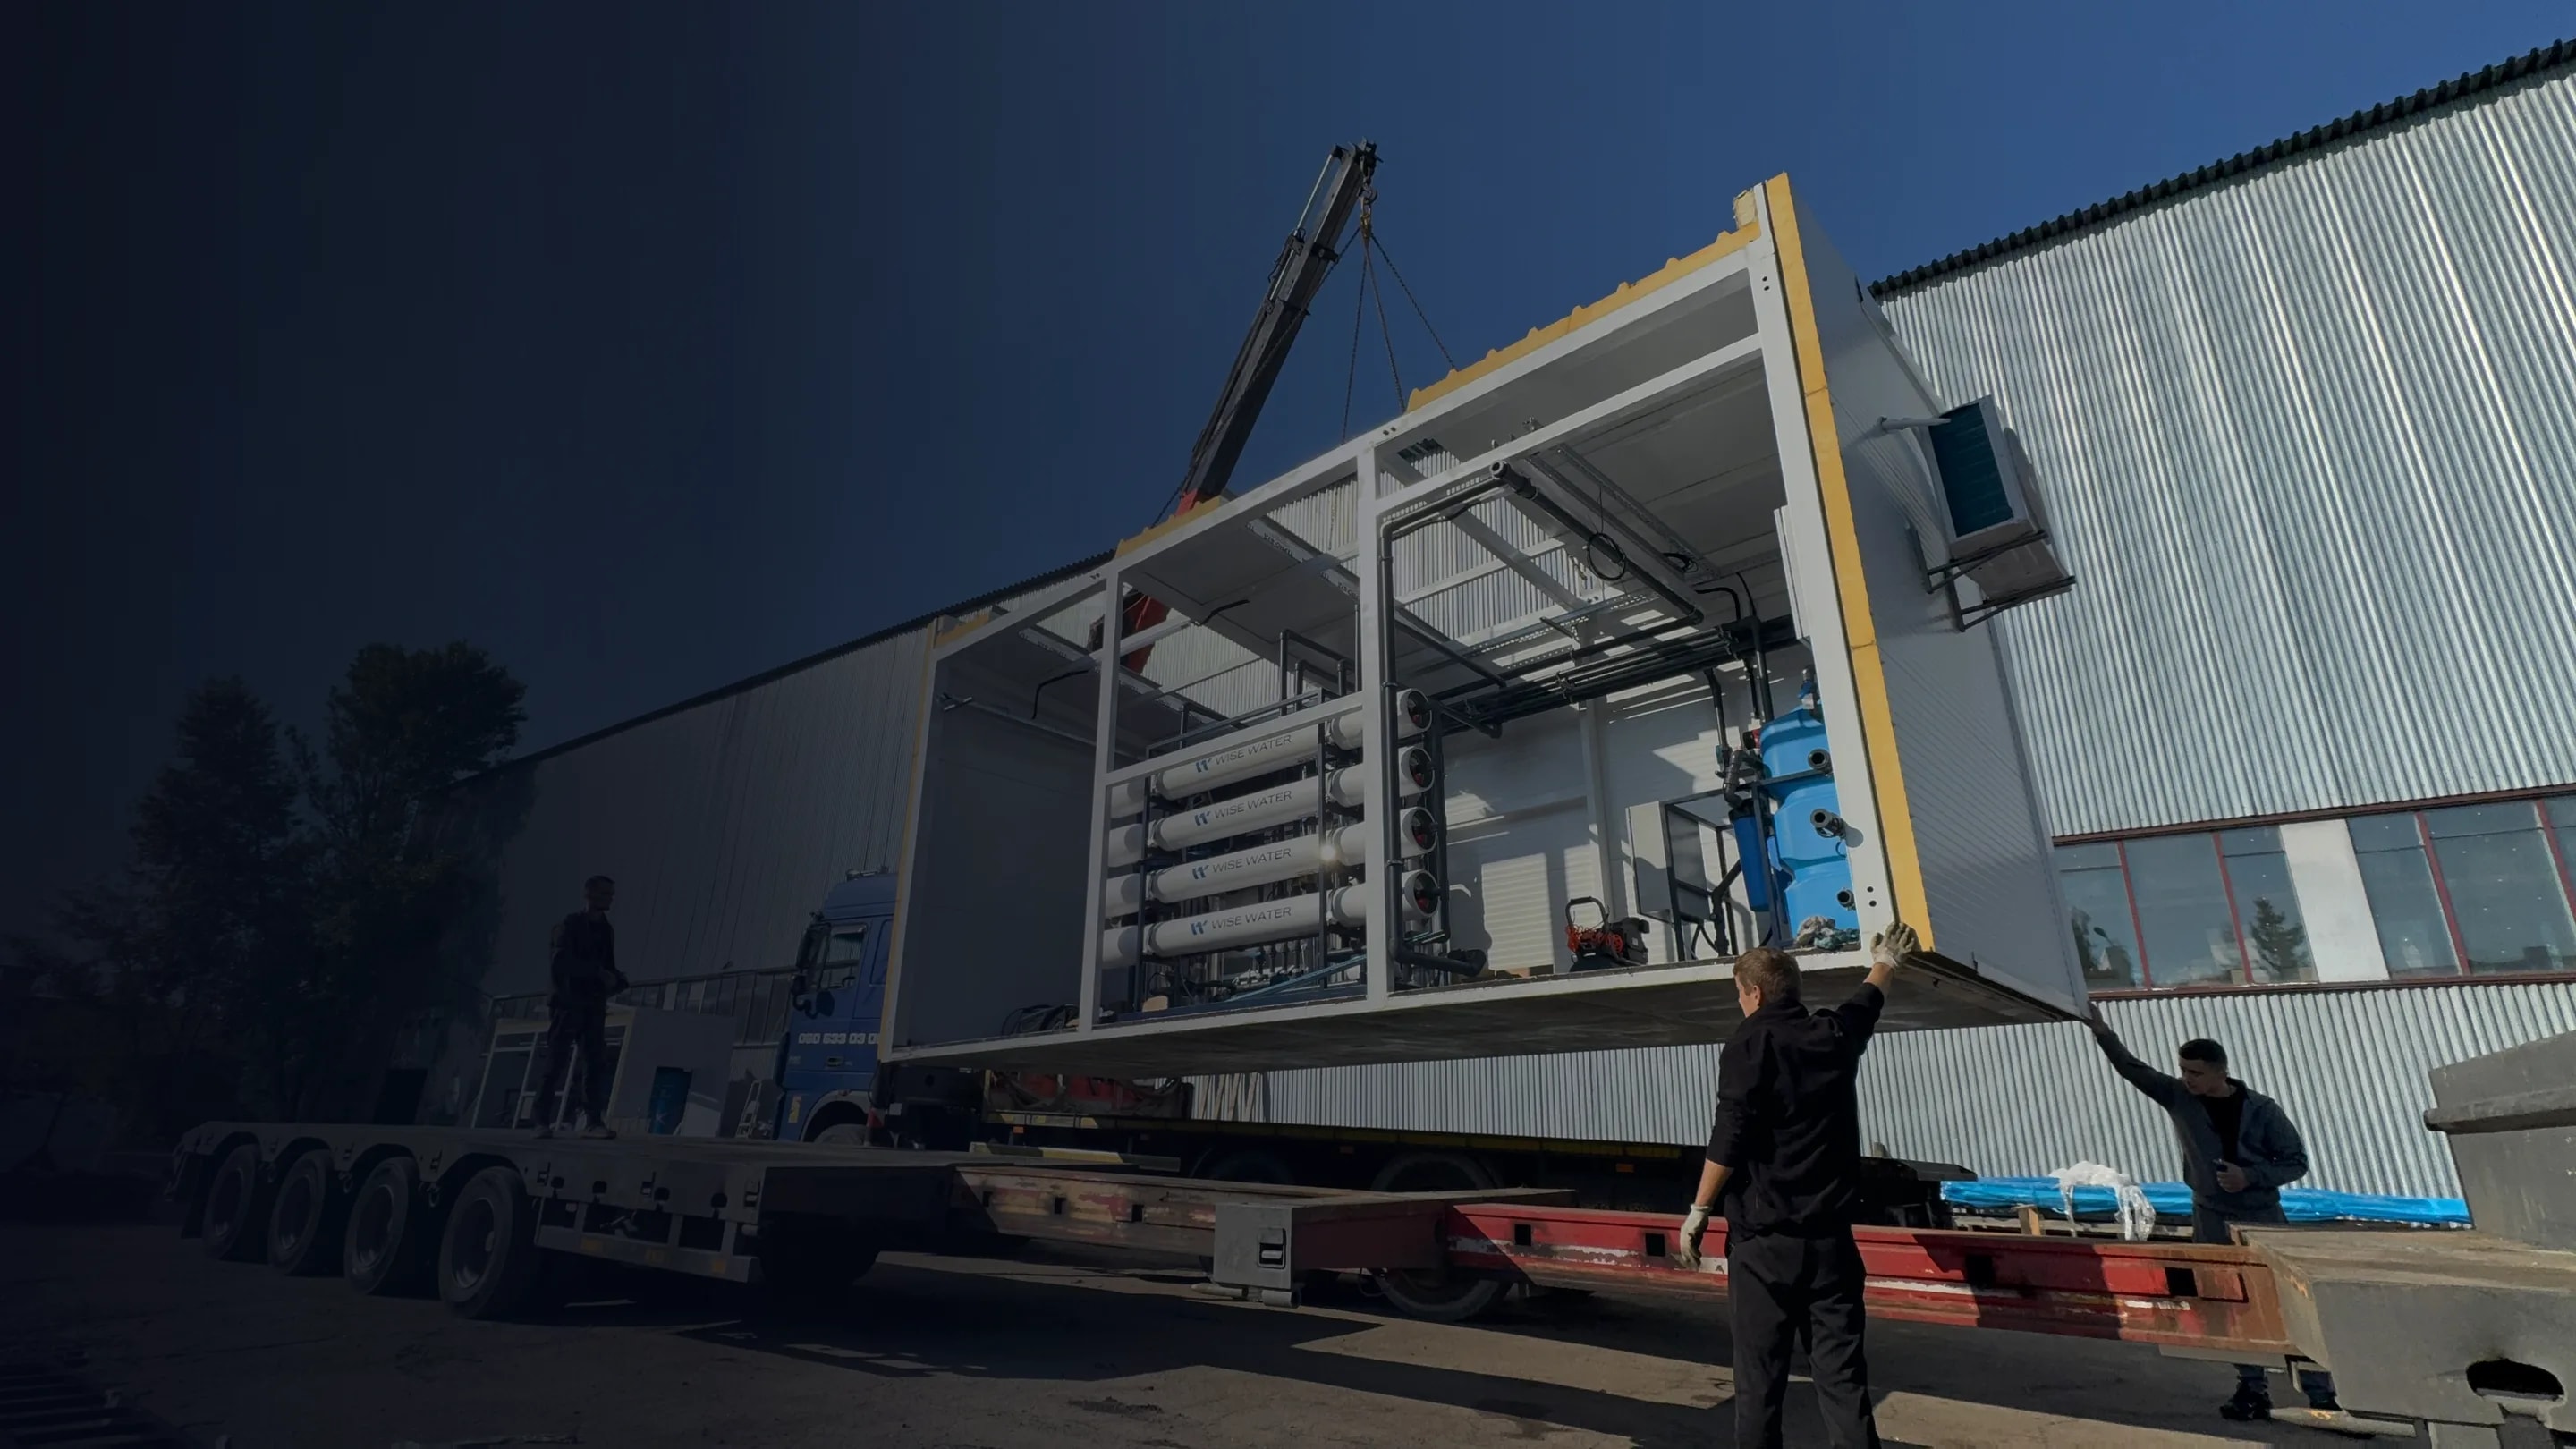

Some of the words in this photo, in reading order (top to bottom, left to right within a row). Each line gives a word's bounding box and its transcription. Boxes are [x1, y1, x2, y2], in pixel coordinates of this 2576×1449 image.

[1215, 750, 1245, 765] WISE
[1248, 734, 1292, 755] WATER
[1215, 803, 1245, 818] WISE
[1247, 790, 1292, 809] WATER
[1212, 859, 1242, 873] WISE
[1246, 848, 1292, 866] WATER
[1211, 916, 1241, 929] WISE
[1245, 906, 1292, 924] WATER
